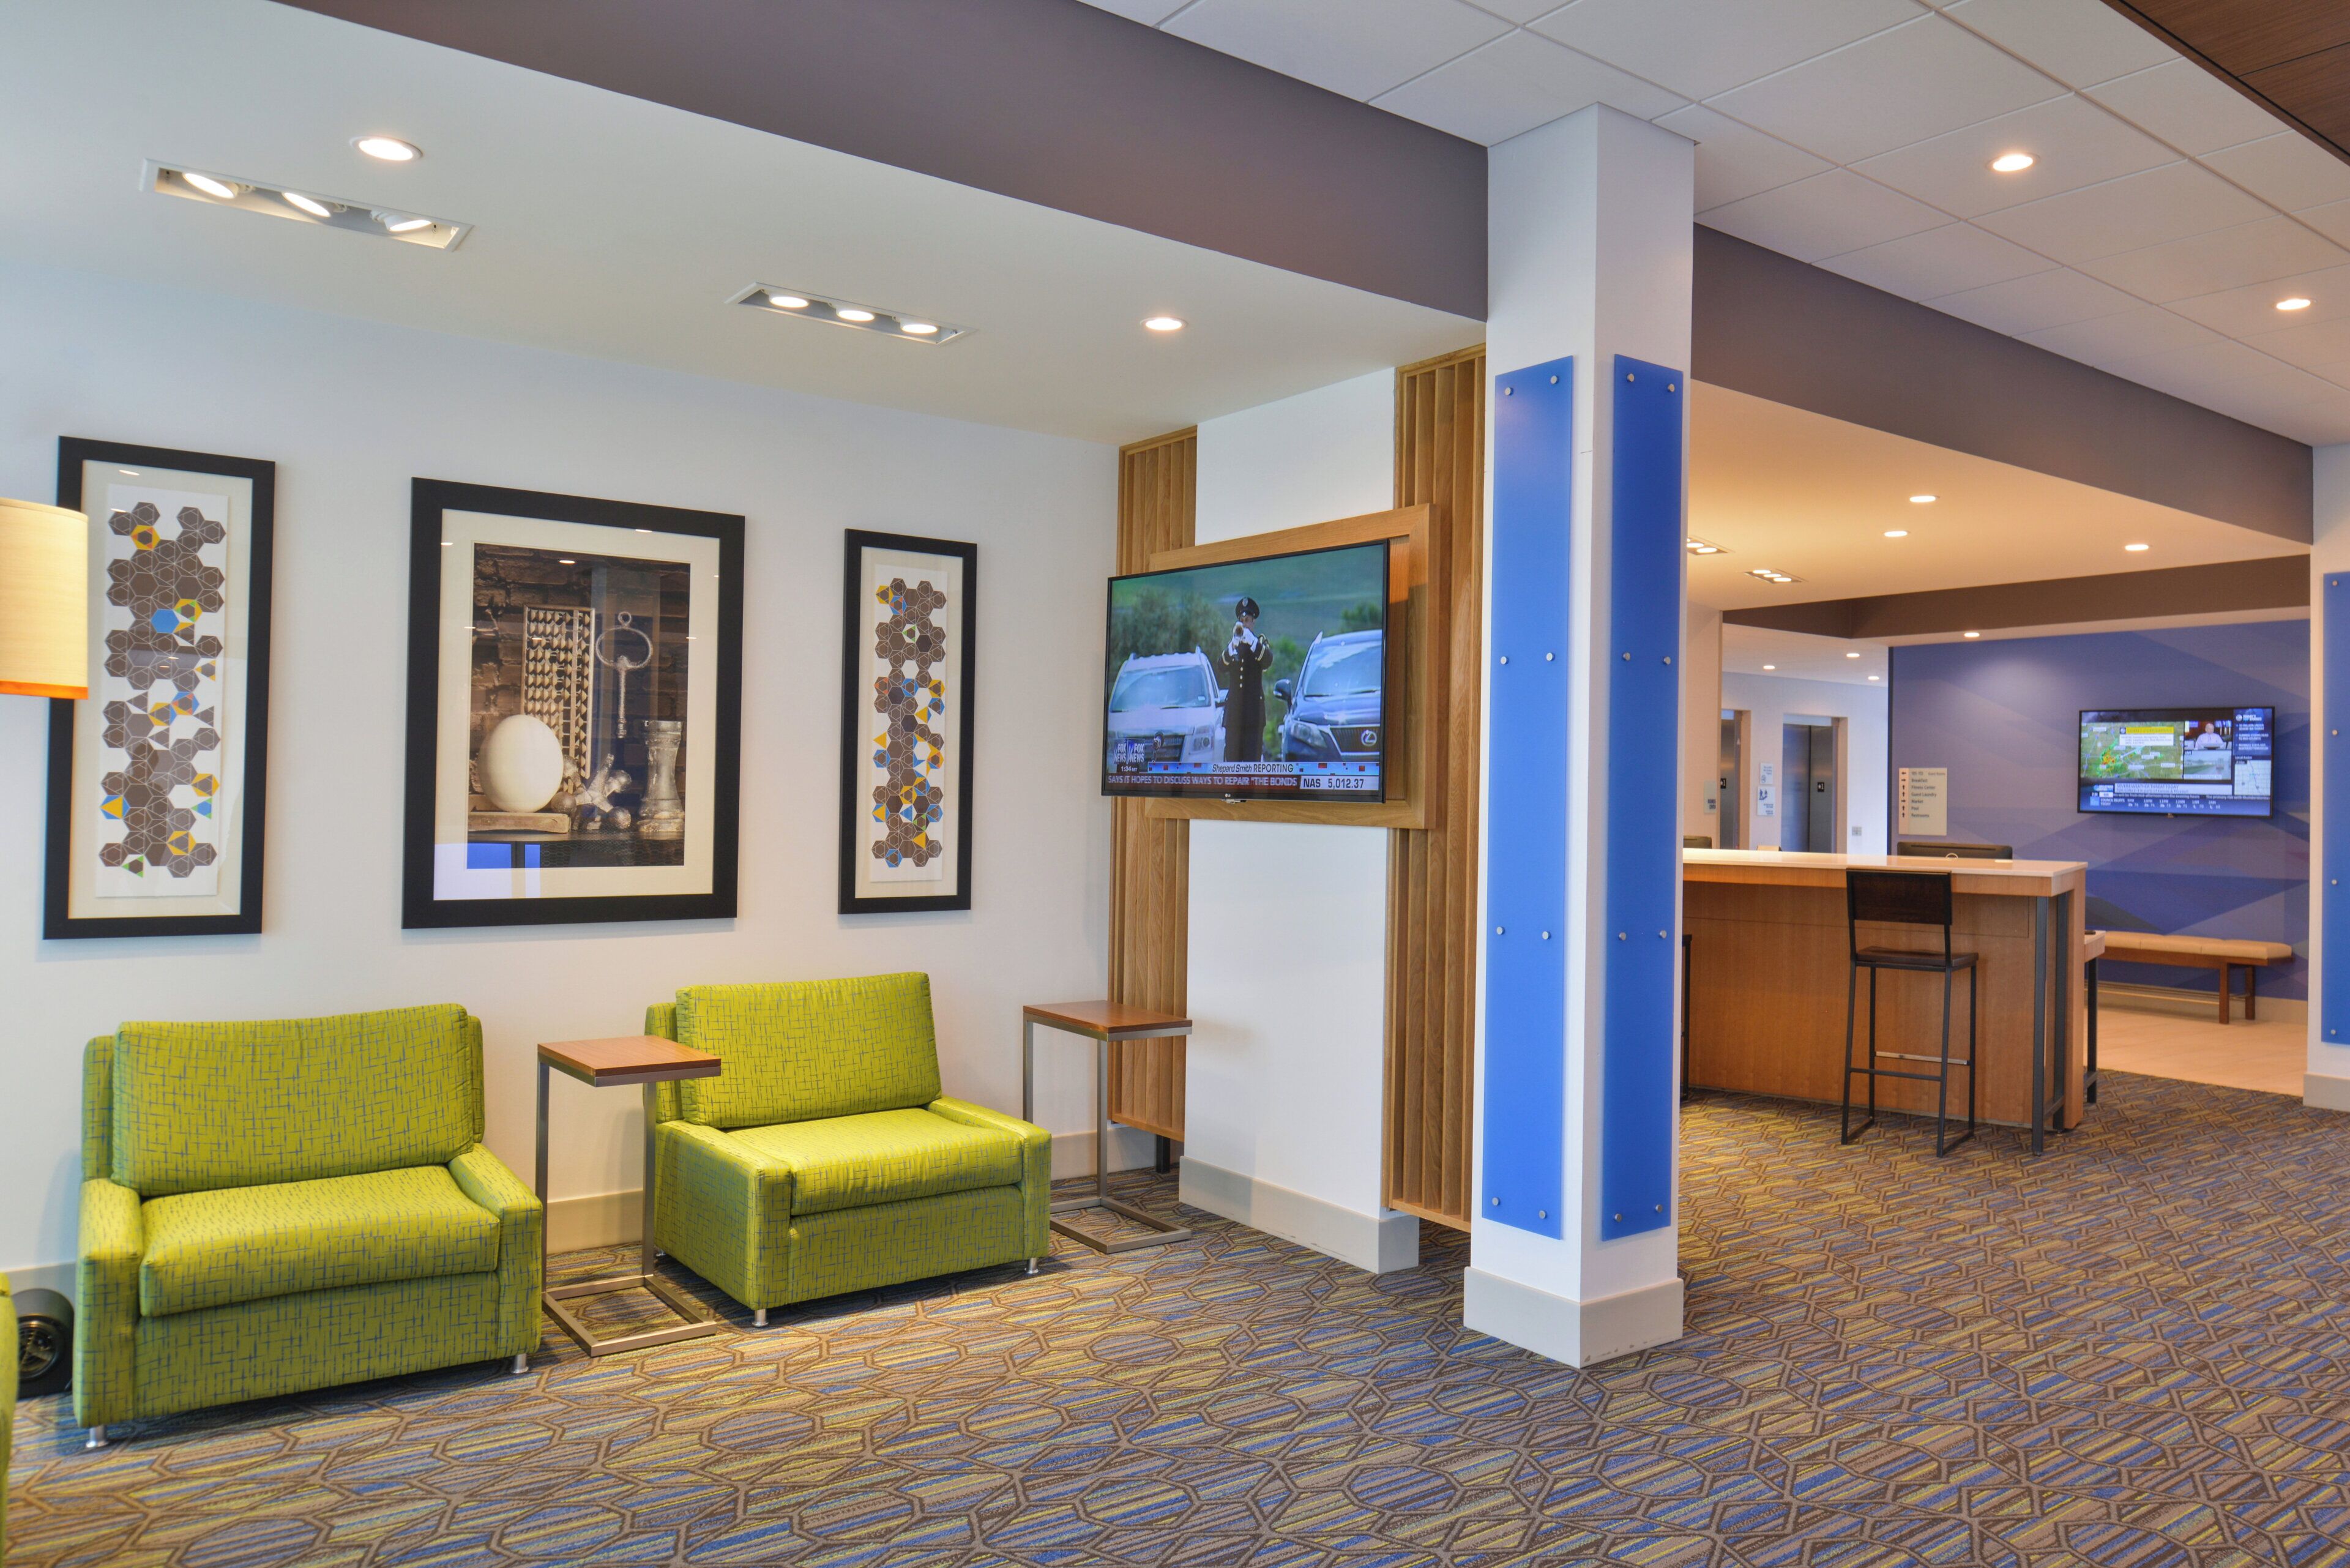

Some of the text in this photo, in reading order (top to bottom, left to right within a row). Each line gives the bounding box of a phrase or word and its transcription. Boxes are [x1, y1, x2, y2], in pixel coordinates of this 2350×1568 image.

[1118, 743, 1127, 753] FOX
[1134, 743, 1144, 753] FOX
[1130, 753, 1145, 763] NEWS
[1212, 763, 1294, 774] Shepard Smith REPORTING
[1214, 777, 1224, 785] TO
[1225, 777, 1249, 785] REPAIR
[1270, 777, 1297, 786] BONDS
[1304, 778, 1364, 790] NAS 5,012.37
